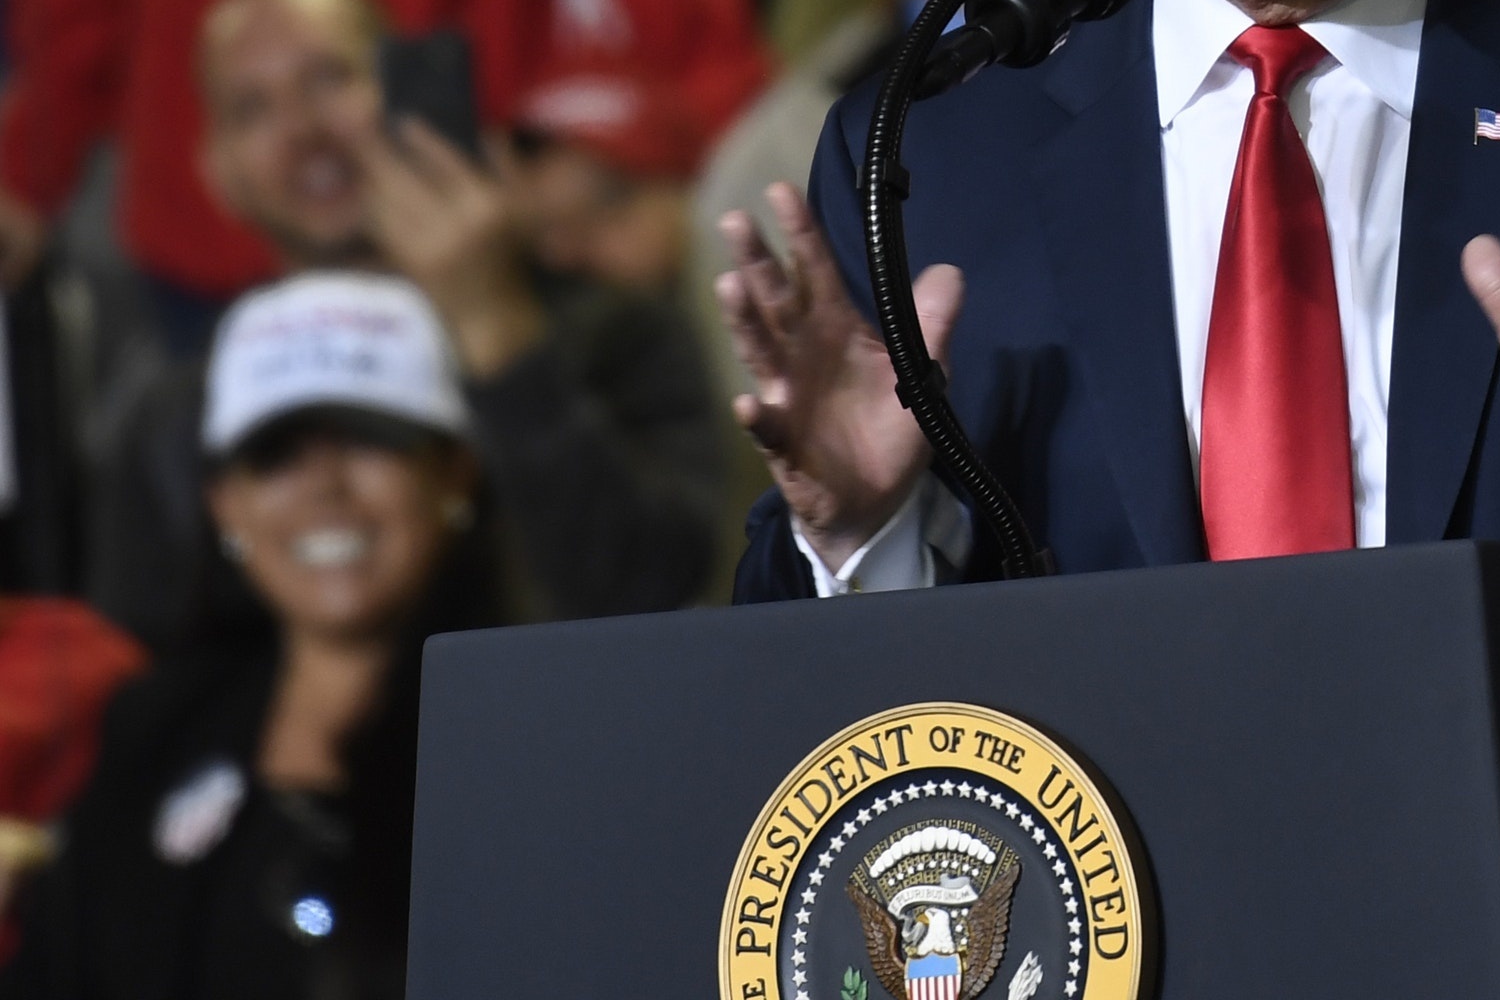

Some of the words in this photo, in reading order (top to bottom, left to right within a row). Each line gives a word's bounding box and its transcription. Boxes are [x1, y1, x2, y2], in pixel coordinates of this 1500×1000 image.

[736, 723, 914, 957] PRESIDENT
[929, 726, 965, 753] OF
[974, 730, 1026, 775] THE
[1037, 764, 1129, 960] UNITED
